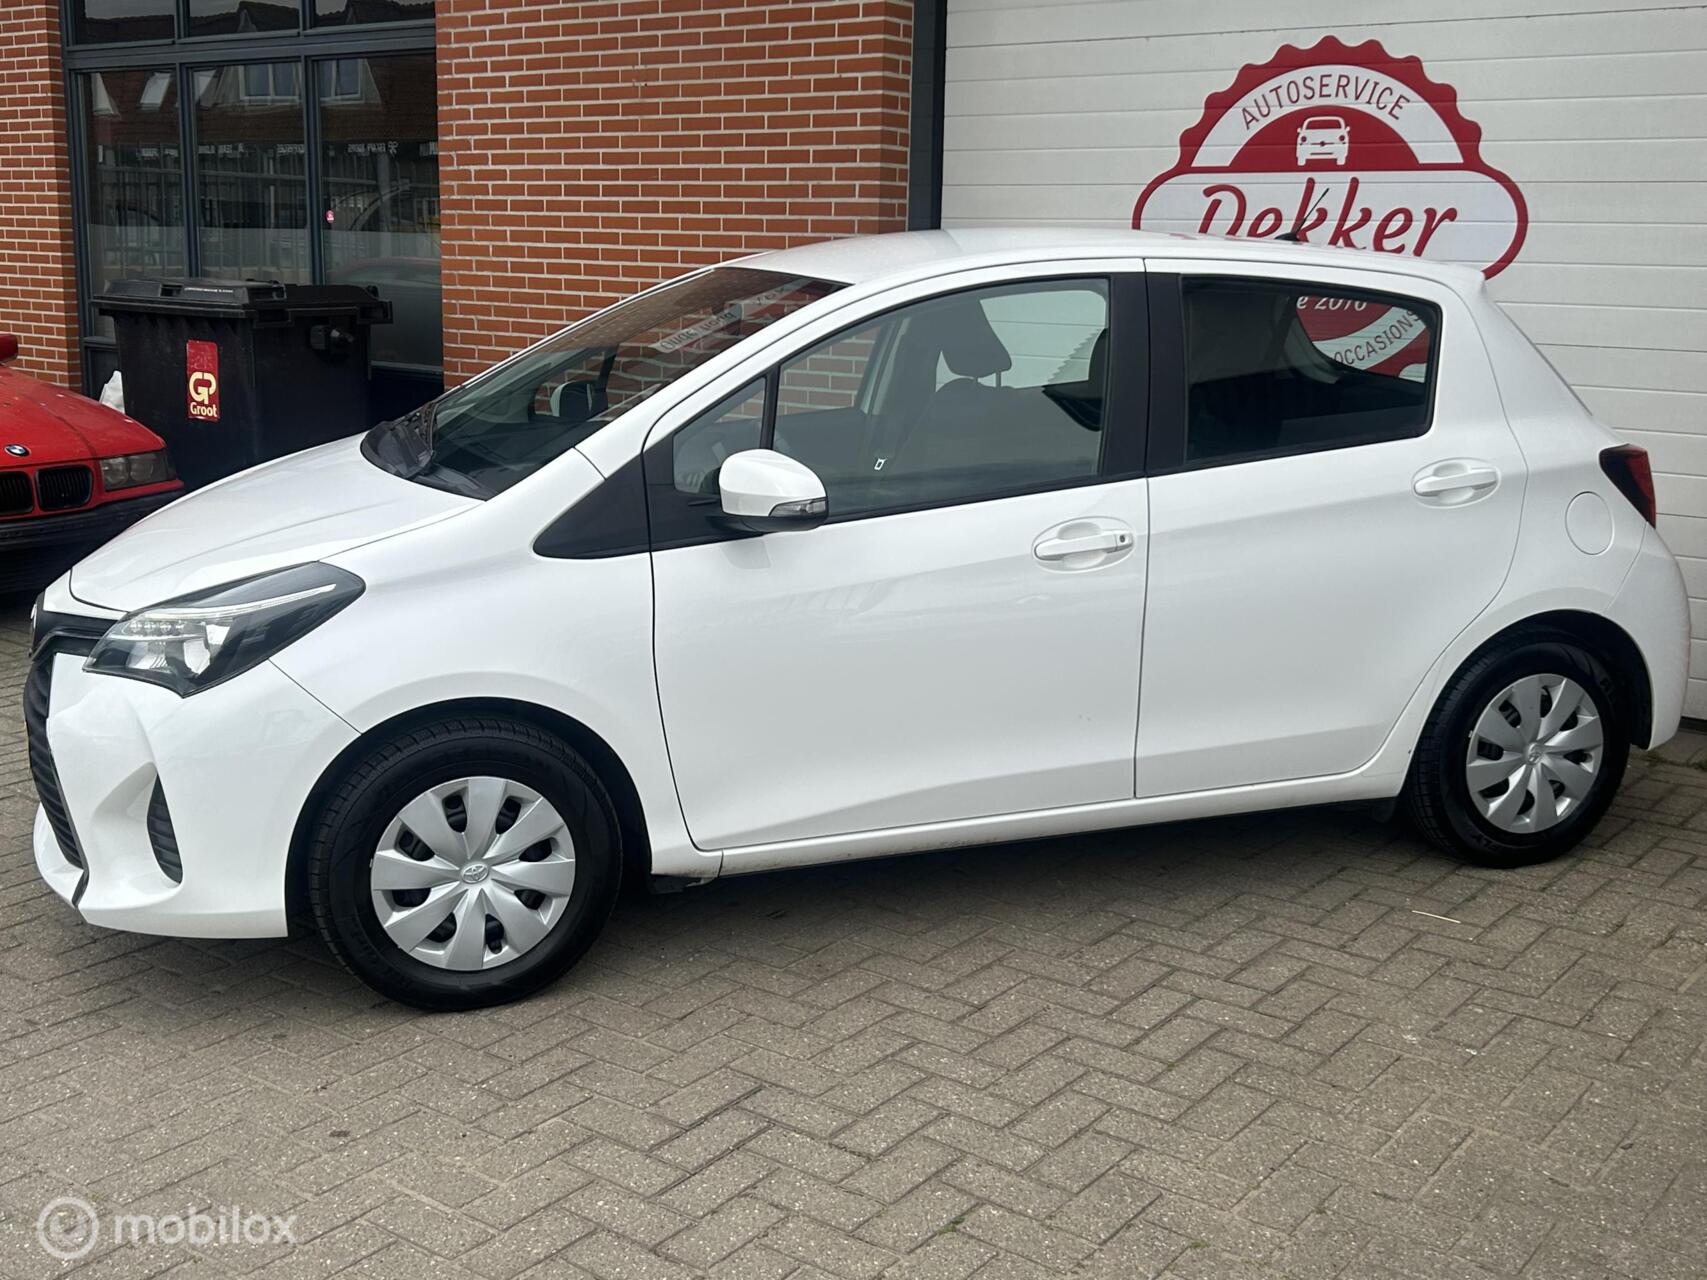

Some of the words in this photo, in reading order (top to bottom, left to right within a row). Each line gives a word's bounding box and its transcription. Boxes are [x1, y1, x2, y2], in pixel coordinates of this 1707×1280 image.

[1241, 74, 1411, 130] AUTOSERVICE
[1198, 177, 1458, 257] Dekker
[190, 402, 217, 418] Groot
